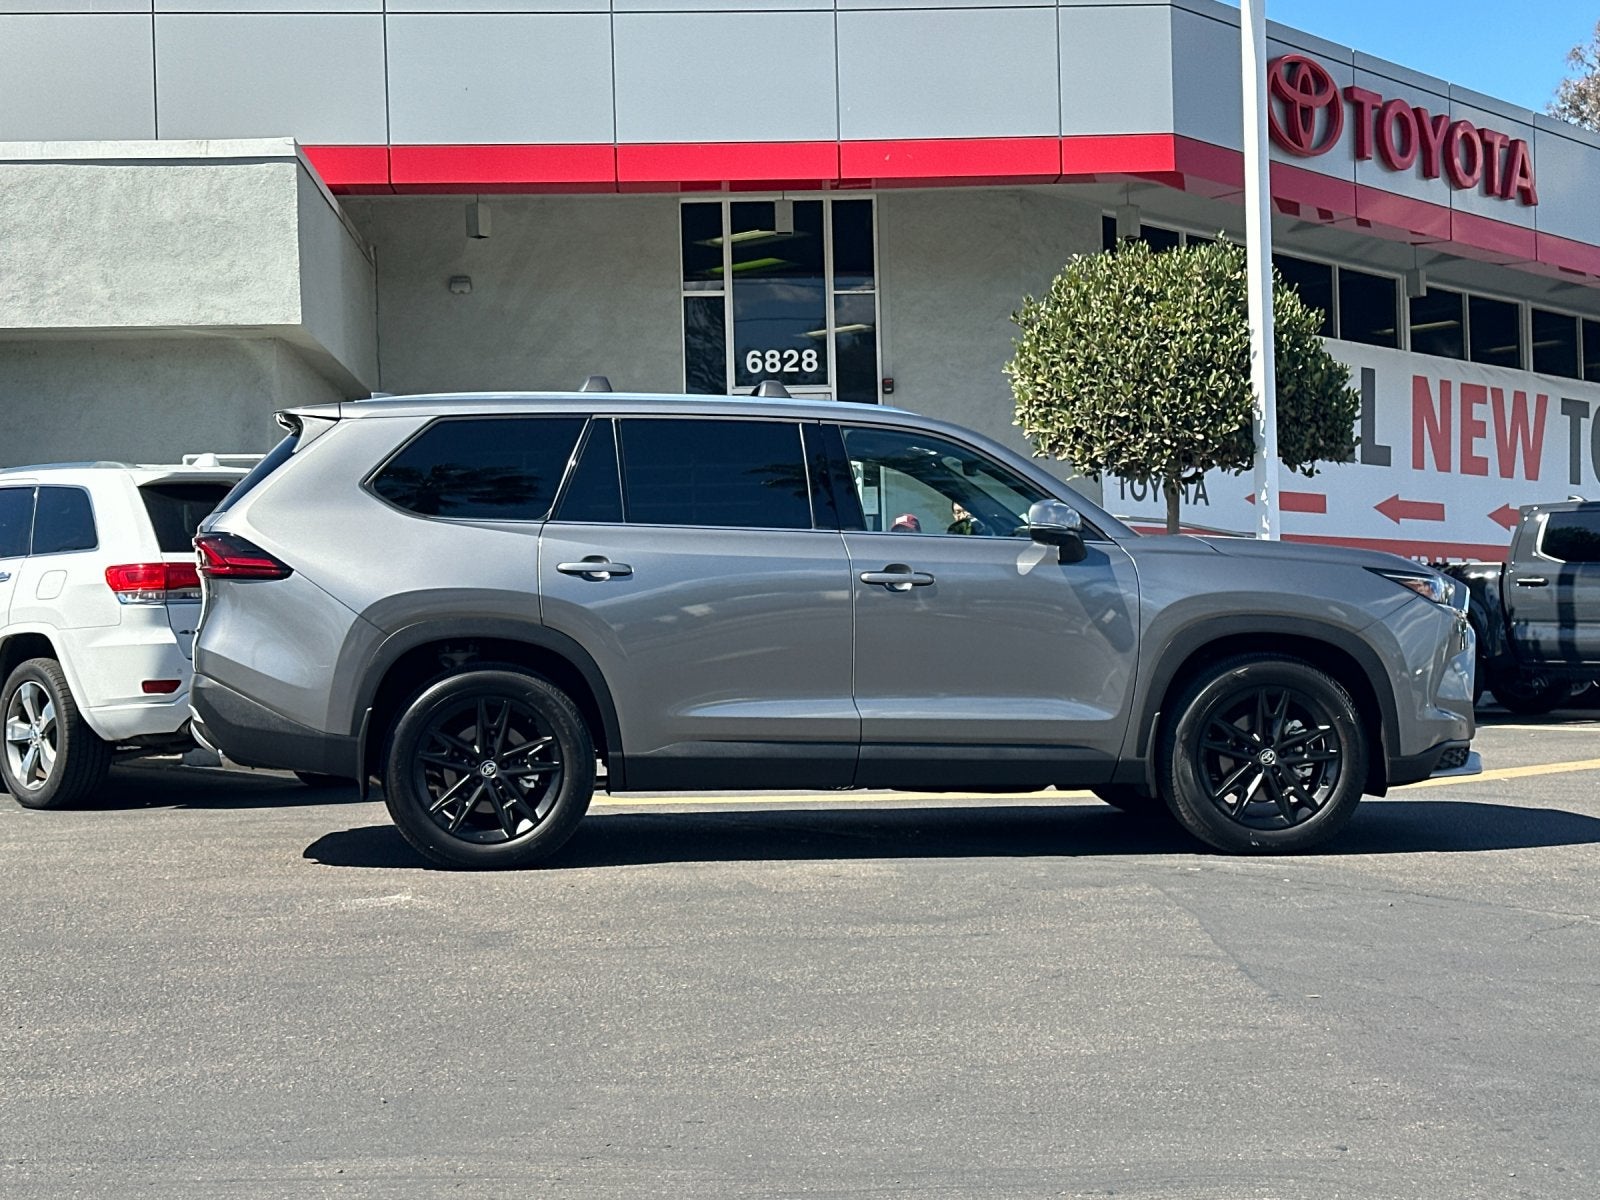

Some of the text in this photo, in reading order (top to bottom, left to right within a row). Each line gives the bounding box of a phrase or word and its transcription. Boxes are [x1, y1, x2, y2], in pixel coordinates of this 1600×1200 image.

[1344, 85, 1538, 206] TOYOTA
[746, 349, 818, 373] 6828
[1412, 375, 1548, 481] NEW
[1116, 472, 1209, 506] TOYTA
